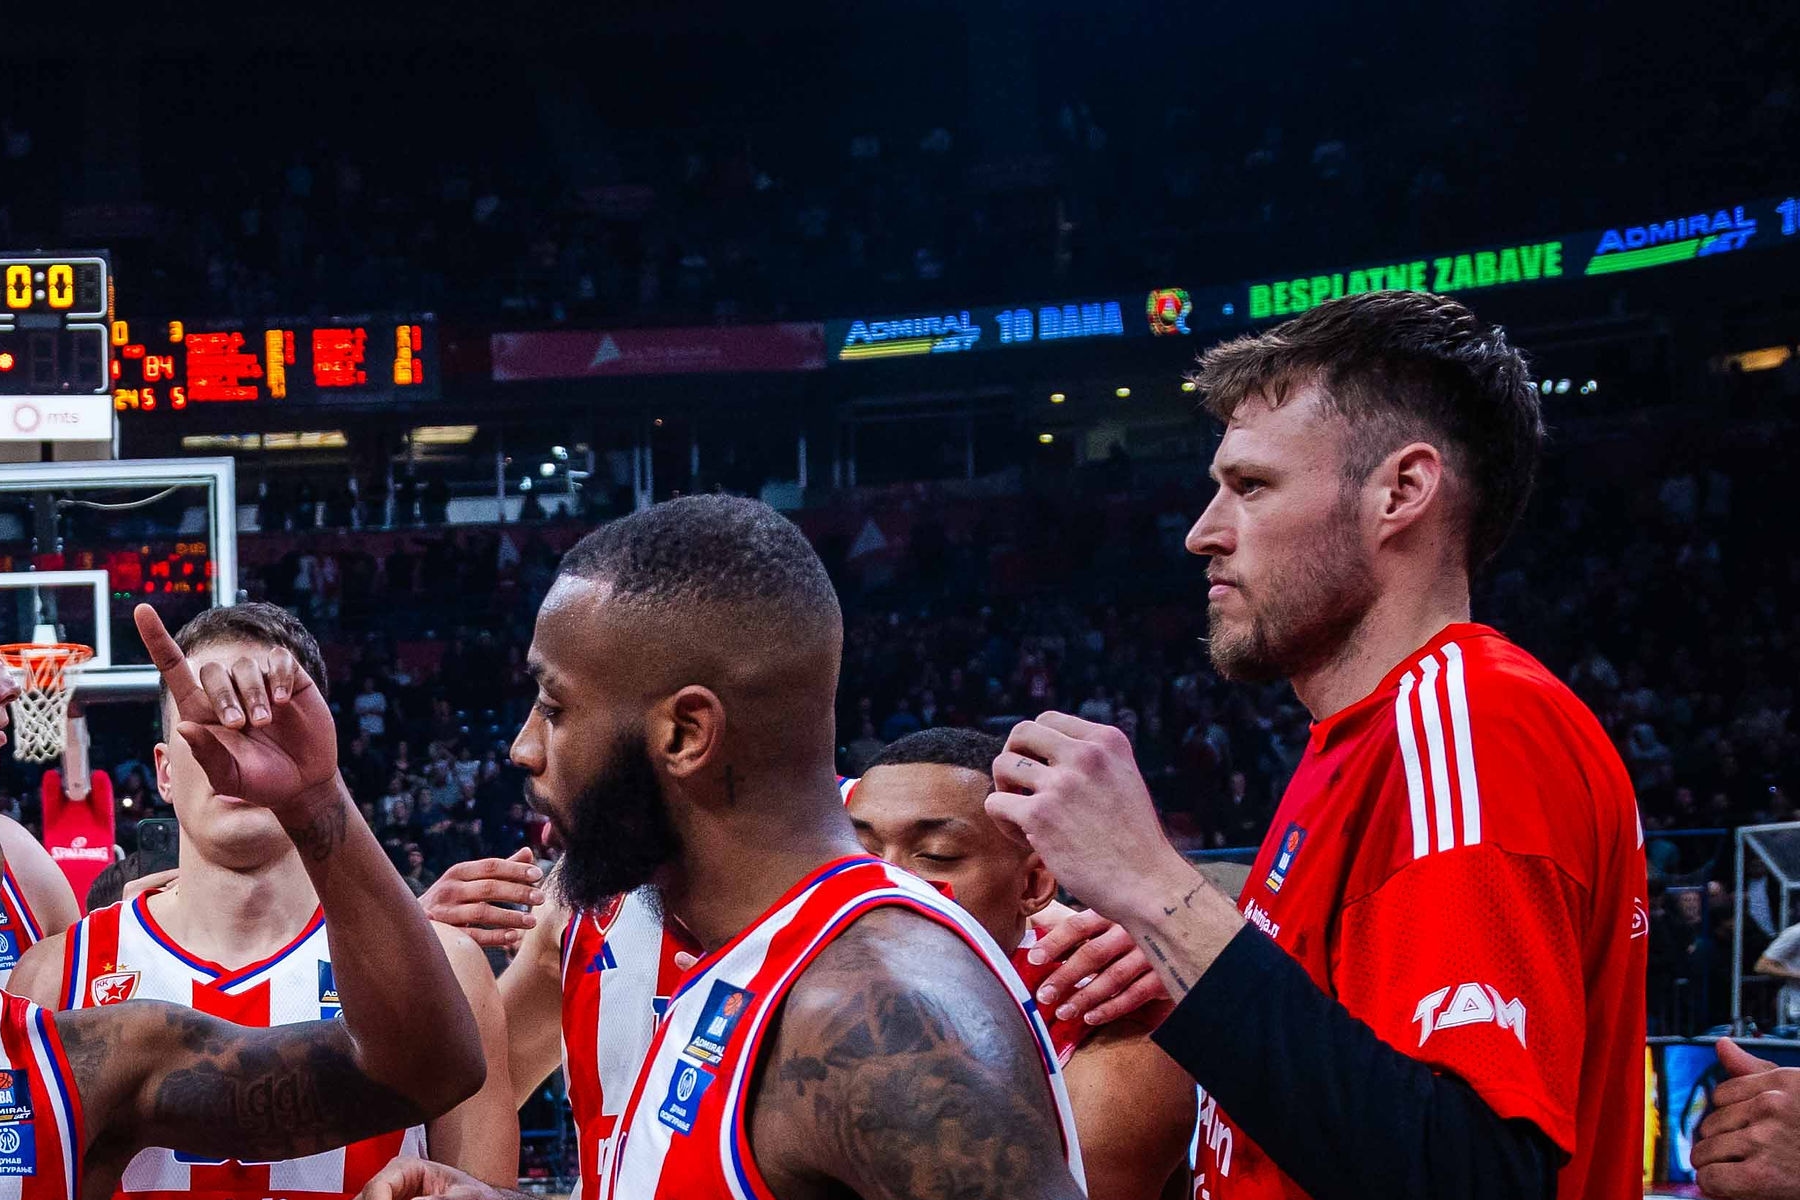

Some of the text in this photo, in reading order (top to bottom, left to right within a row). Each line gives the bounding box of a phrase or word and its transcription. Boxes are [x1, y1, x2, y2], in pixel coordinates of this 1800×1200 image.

[1596, 206, 1757, 254] ADMIRAL
[1776, 197, 1800, 235] 1
[1250, 241, 1563, 318] BESPLATNE ZABAVE
[845, 311, 981, 345] ADMIRAL
[47, 411, 80, 424] mts
[51, 846, 108, 861] SPALDING
